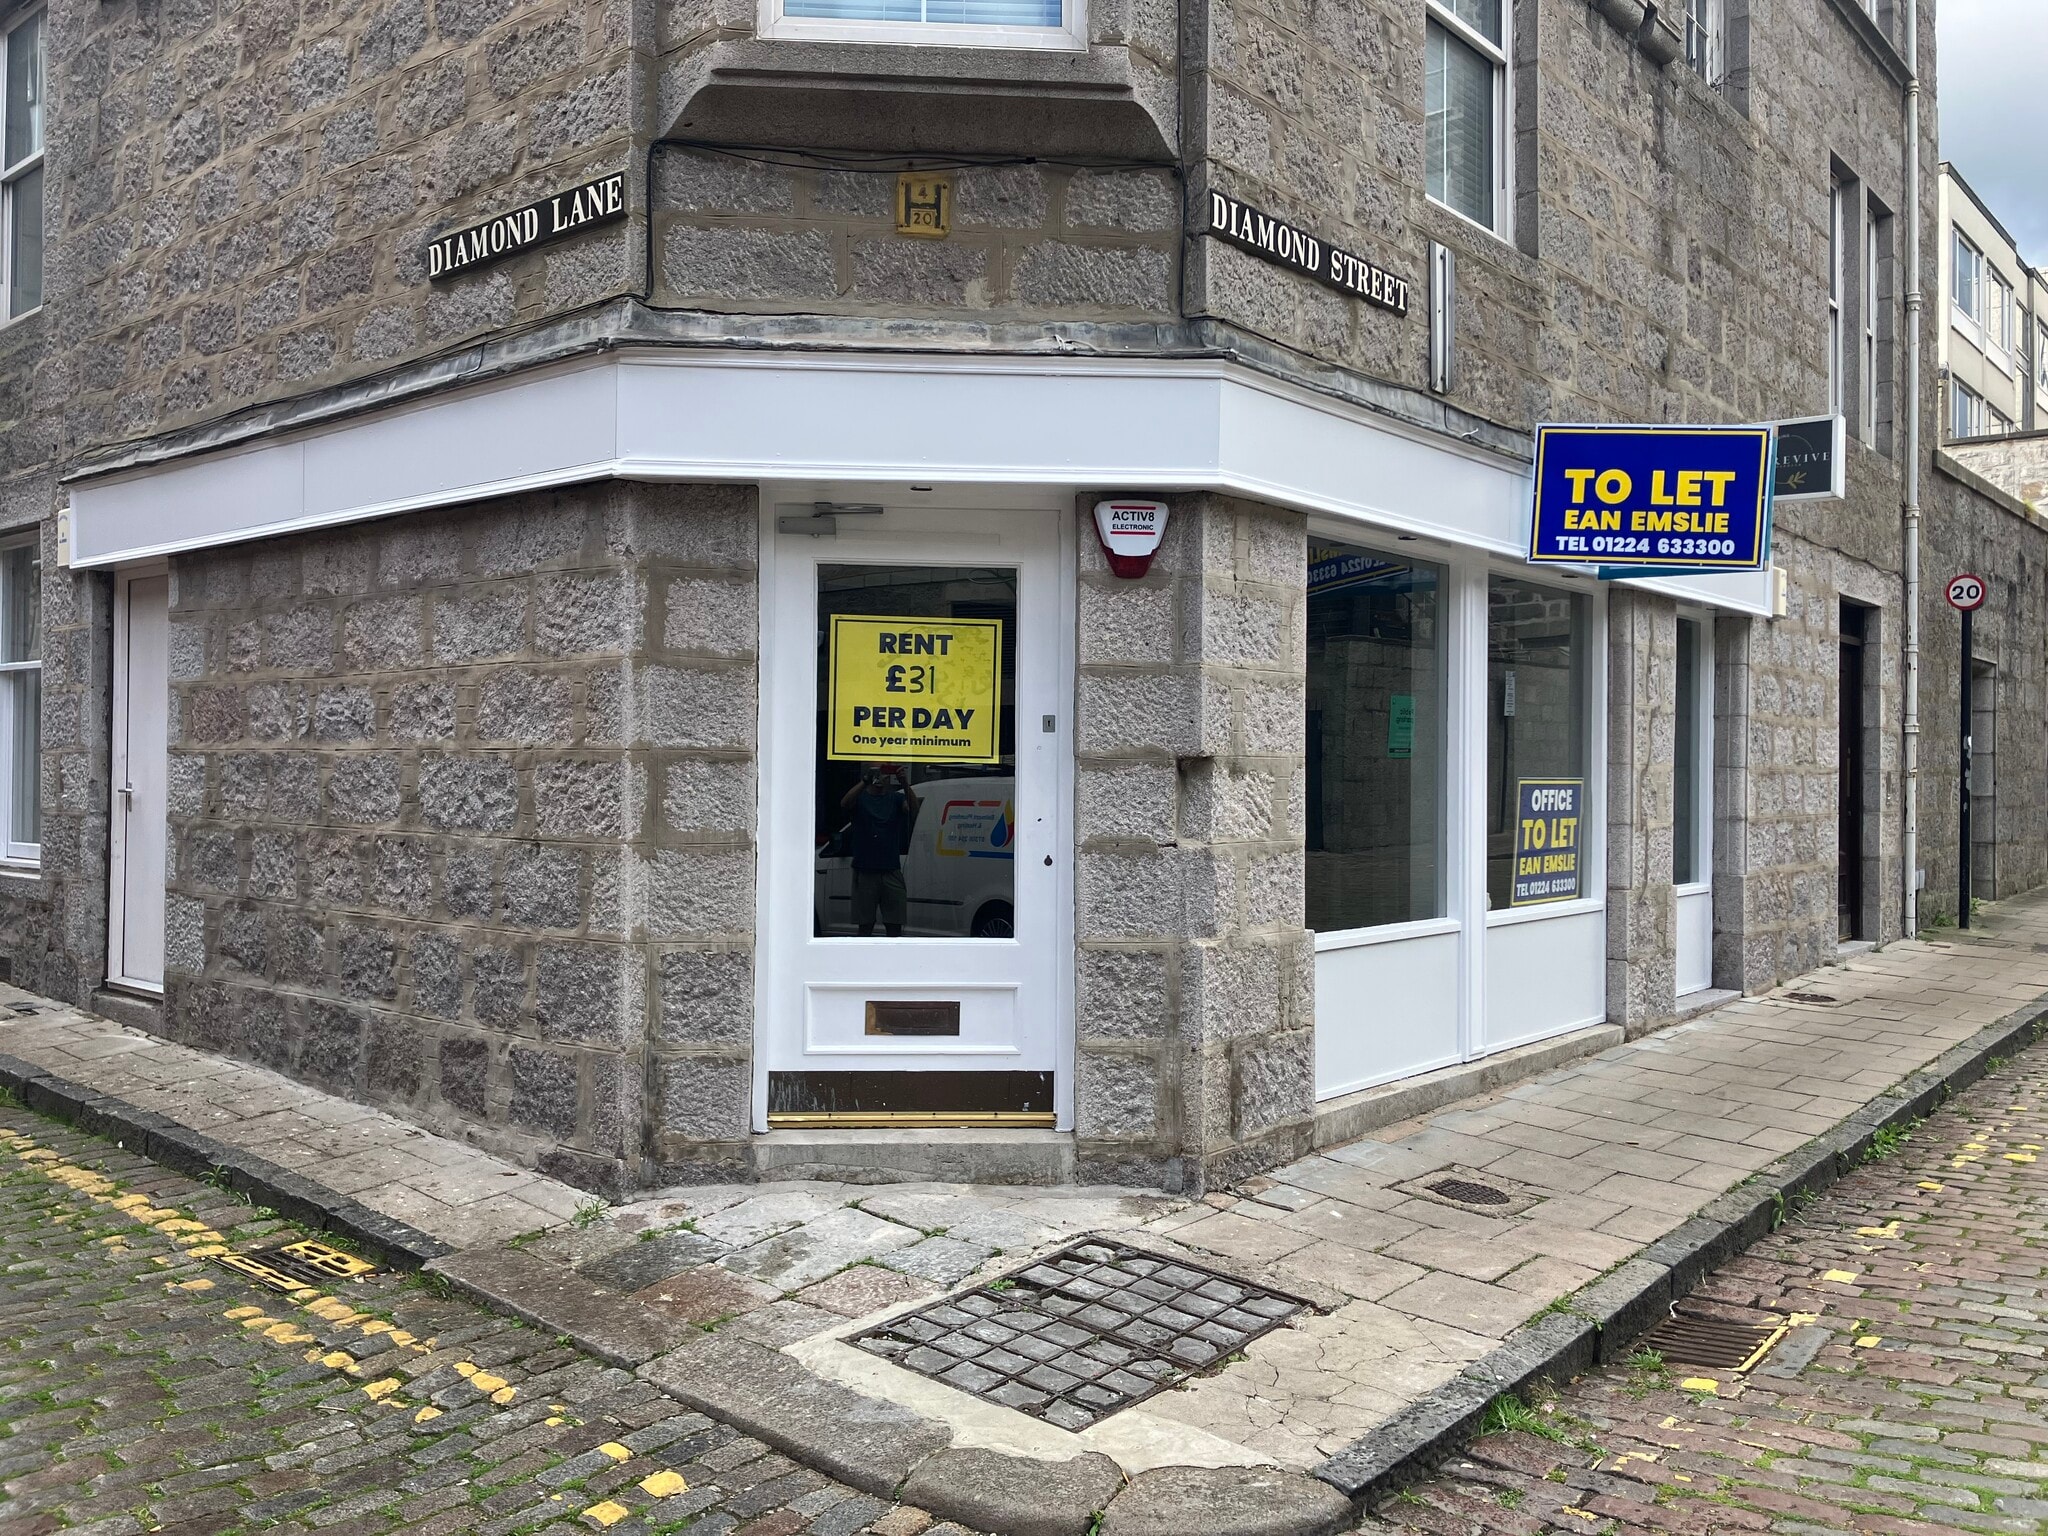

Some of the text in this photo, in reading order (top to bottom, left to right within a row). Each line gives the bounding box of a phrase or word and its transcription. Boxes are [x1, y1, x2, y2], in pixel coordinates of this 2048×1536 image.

[918, 185, 928, 199] 4
[428, 175, 622, 277] DIAMOND LANE
[913, 212, 932, 225] 20
[1212, 192, 1408, 311] DIAMOND STREET
[1564, 468, 1736, 507] TO LET
[1112, 510, 1155, 522] ACTIV8
[1112, 523, 1154, 531] ELECTRONIC
[1564, 509, 1730, 534] EAN EMSLIE
[1555, 535, 1736, 556] TEL 01224 633300
[1952, 585, 1980, 600] 20
[879, 632, 954, 656] RENT
[885, 664, 935, 694] £31
[853, 706, 975, 730] PER DAY
[852, 734, 971, 748] One year minimum
[1531, 789, 1573, 812] OFFICE
[1522, 818, 1577, 850] TO LET
[1519, 853, 1576, 876] EAN EMSLIE
[1516, 878, 1576, 897] TEL 01224 633300
